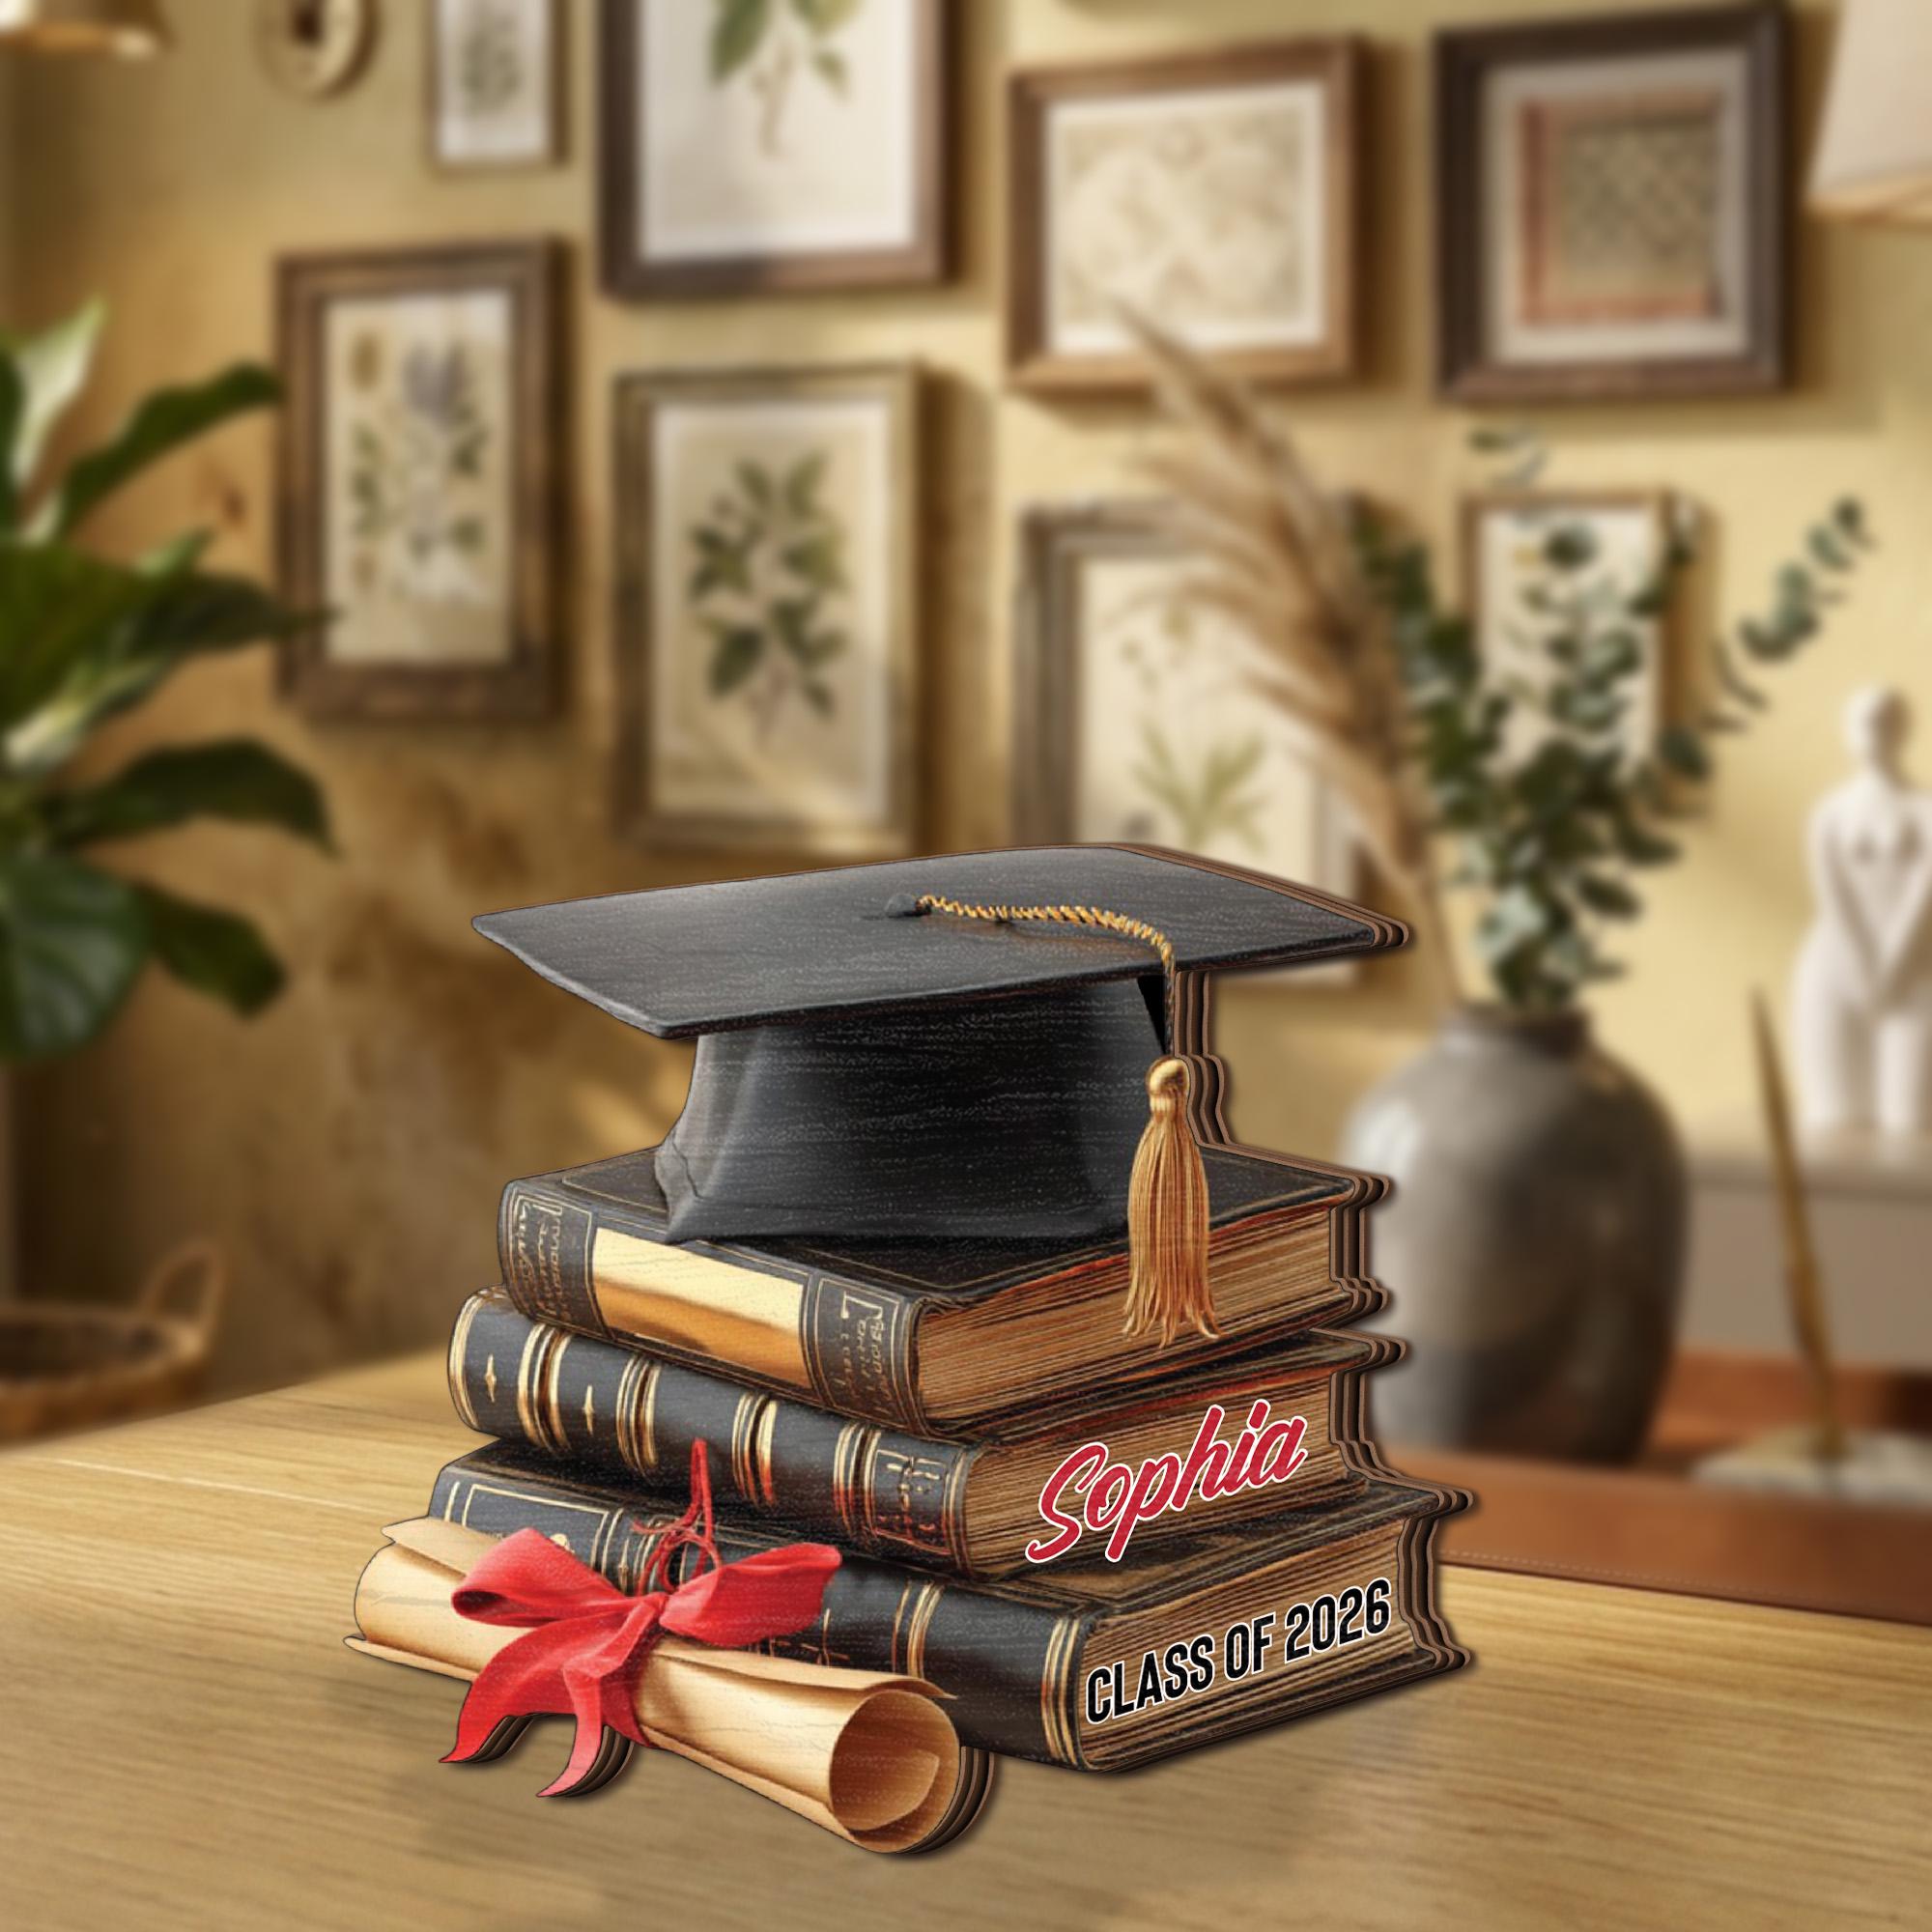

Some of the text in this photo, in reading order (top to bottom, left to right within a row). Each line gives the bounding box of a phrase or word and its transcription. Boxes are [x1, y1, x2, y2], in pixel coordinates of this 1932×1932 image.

[1026, 1400, 1308, 1562] Sophia
[1086, 1577, 1392, 1724] CLASS OF 2026
